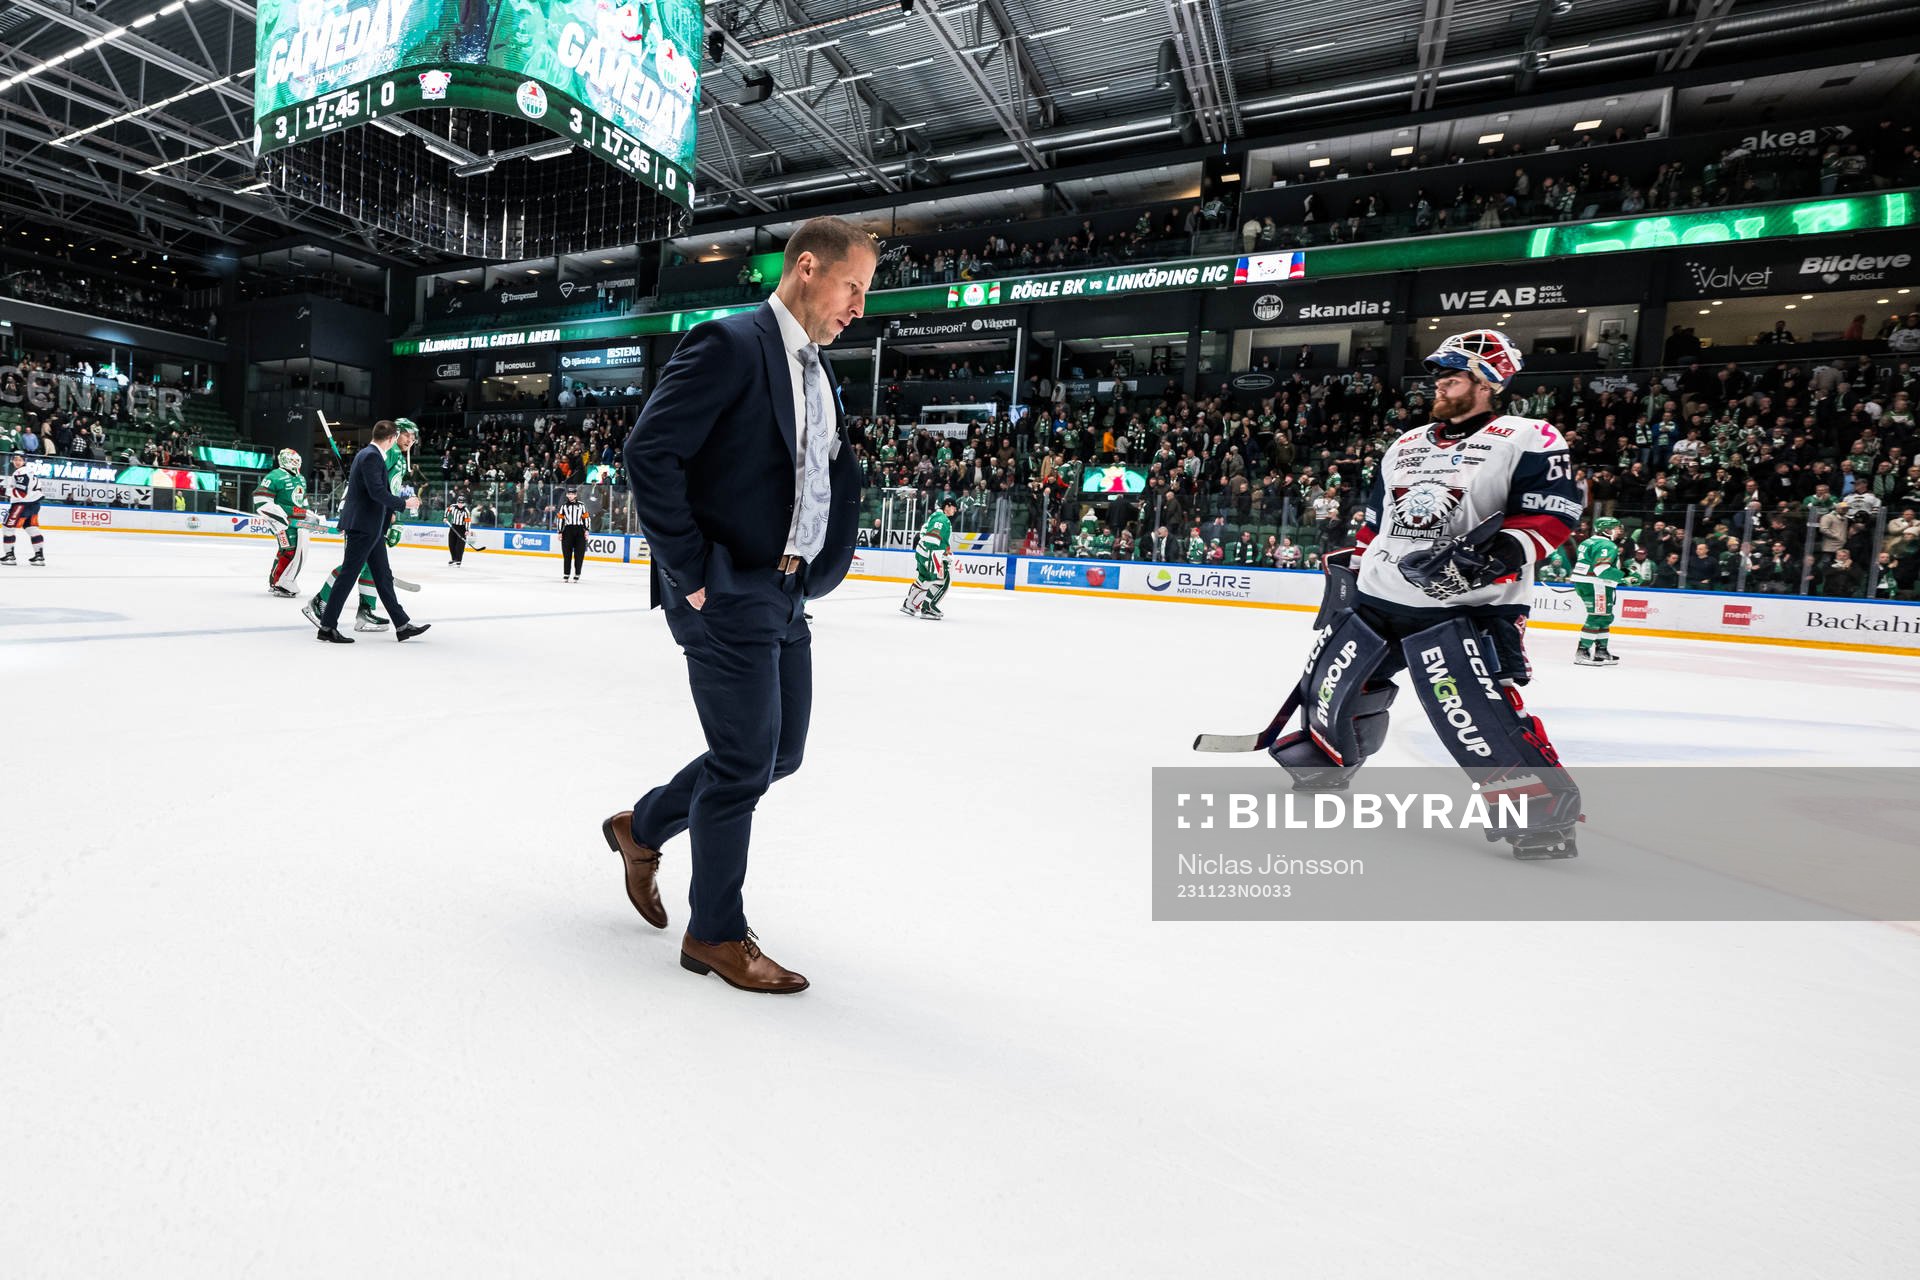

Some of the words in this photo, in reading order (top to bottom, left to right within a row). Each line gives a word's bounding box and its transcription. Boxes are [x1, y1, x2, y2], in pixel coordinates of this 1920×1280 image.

[266, 0, 413, 88] GAMEDAY
[558, 22, 692, 140] GAMEDAY
[275, 115, 288, 139] 3
[305, 91, 360, 130] 17:45
[380, 81, 395, 107] 0
[569, 107, 583, 134] 3
[602, 126, 650, 174] 17:45
[665, 167, 677, 190] 0
[1742, 129, 1816, 151] akea
[1799, 254, 1912, 274] Bildeve
[1010, 280, 1061, 299] RÖGLE
[1062, 278, 1087, 295] BK
[1106, 267, 1199, 291] LINKÖPING
[1201, 265, 1229, 283] HC
[1699, 265, 1773, 288] Valvet
[1440, 287, 1537, 310] WEAB
[491, 332, 525, 347] CATENA
[527, 329, 560, 344] ARENA
[897, 323, 963, 337] RETAILSUPPORT
[61, 483, 131, 500] Fribrocks
[74, 512, 109, 521] ER-HO
[1600, 548, 1608, 557] 3
[1178, 572, 1251, 589] BJÄRE
[1177, 588, 1250, 598] MARKKONSULT
[1304, 624, 1334, 675] CCM
[1462, 638, 1502, 701] CCM
[1316, 641, 1358, 728] EWGROUP
[1420, 646, 1493, 758] EWGROUP
